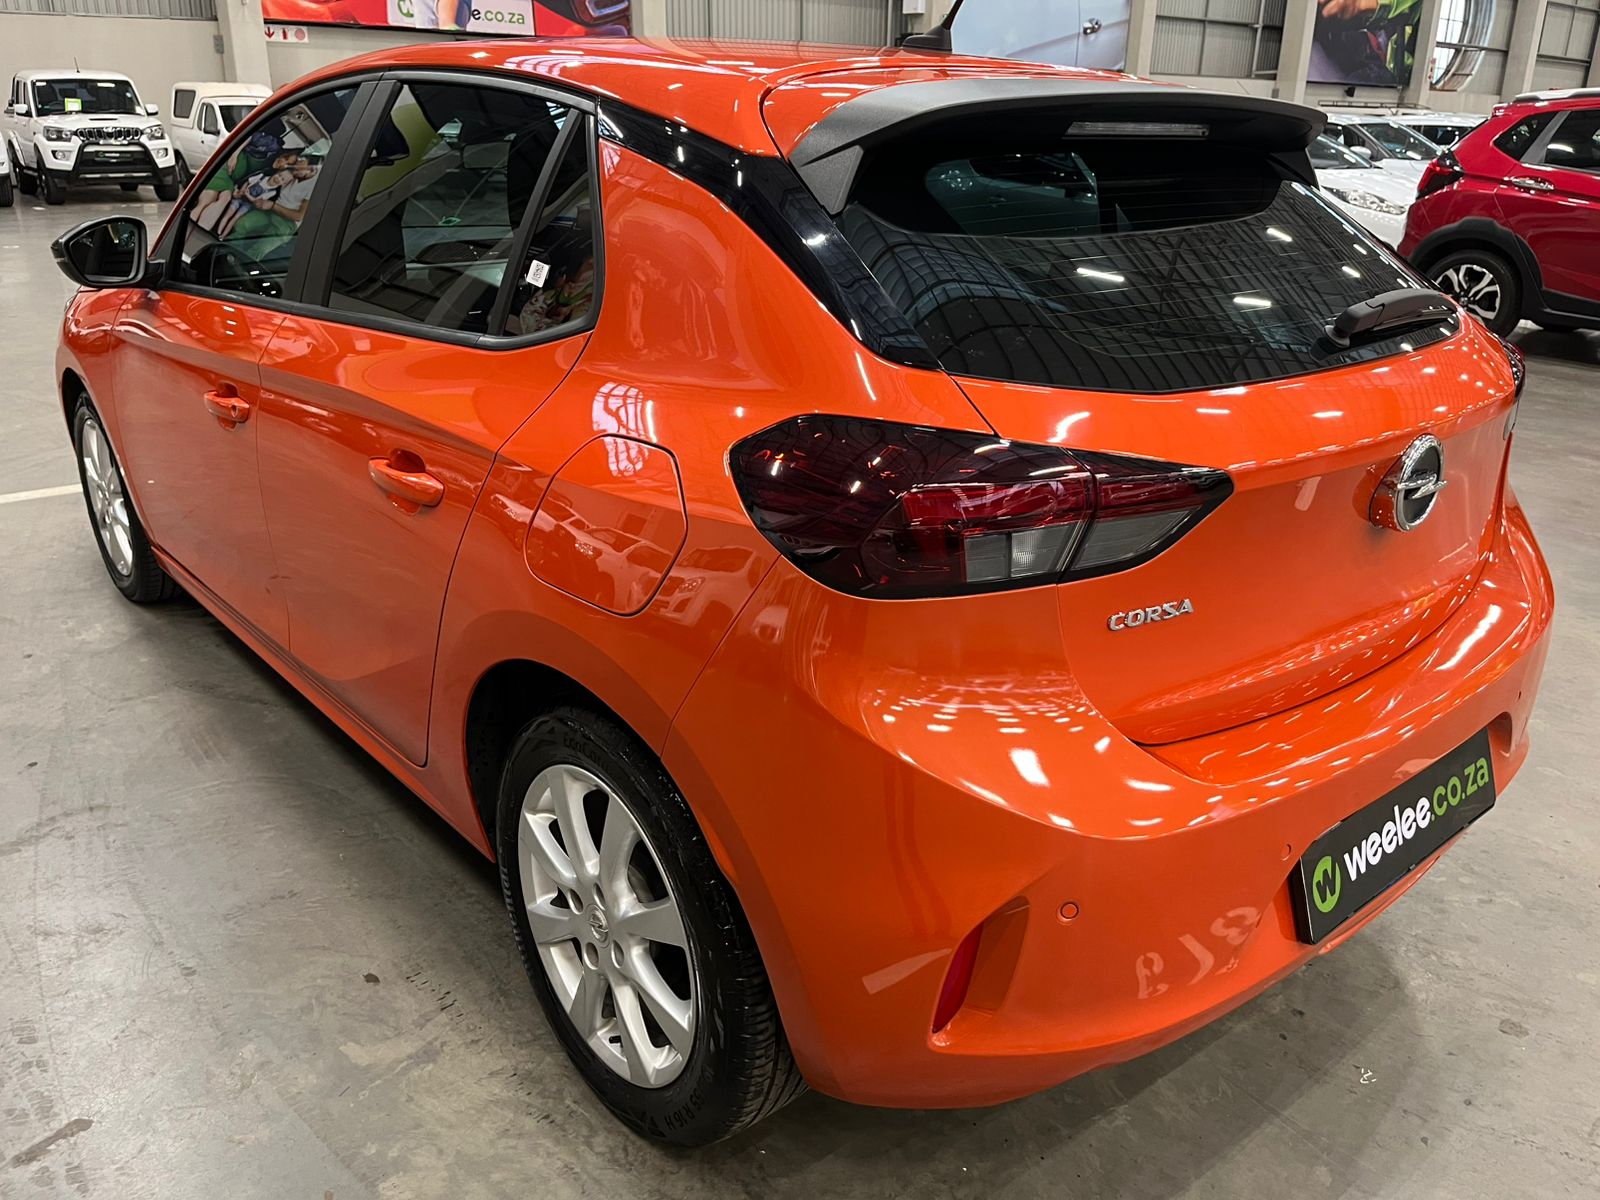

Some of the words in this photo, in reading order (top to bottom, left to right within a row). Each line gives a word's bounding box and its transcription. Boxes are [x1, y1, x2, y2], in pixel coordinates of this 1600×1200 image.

[471, 8, 526, 25] e.co.za
[1107, 598, 1195, 631] CORSA
[1343, 757, 1490, 882] weelee.co.za
